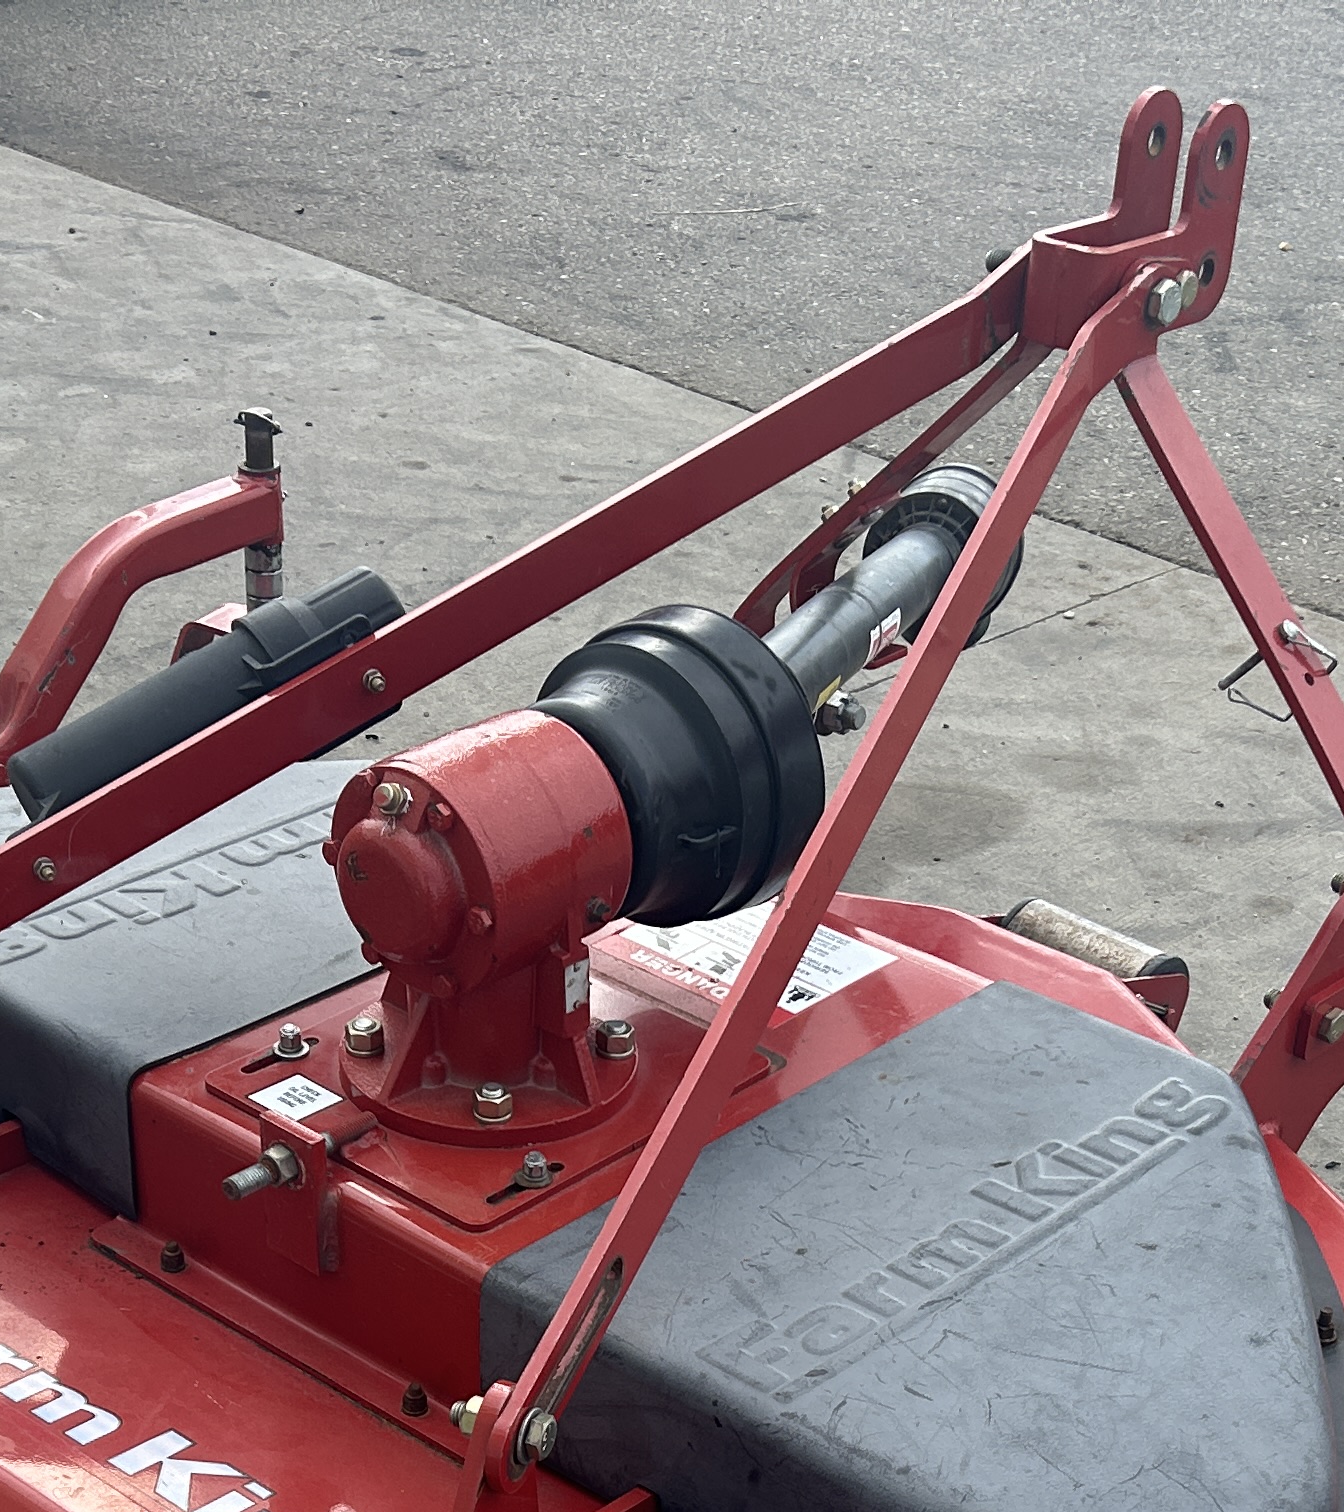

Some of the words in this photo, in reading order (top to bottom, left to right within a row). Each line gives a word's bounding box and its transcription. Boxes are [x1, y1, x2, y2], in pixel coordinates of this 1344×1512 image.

[630, 950, 730, 999] DANGER
[694, 1218, 1013, 1394] Farm
[970, 1077, 1230, 1222] King
